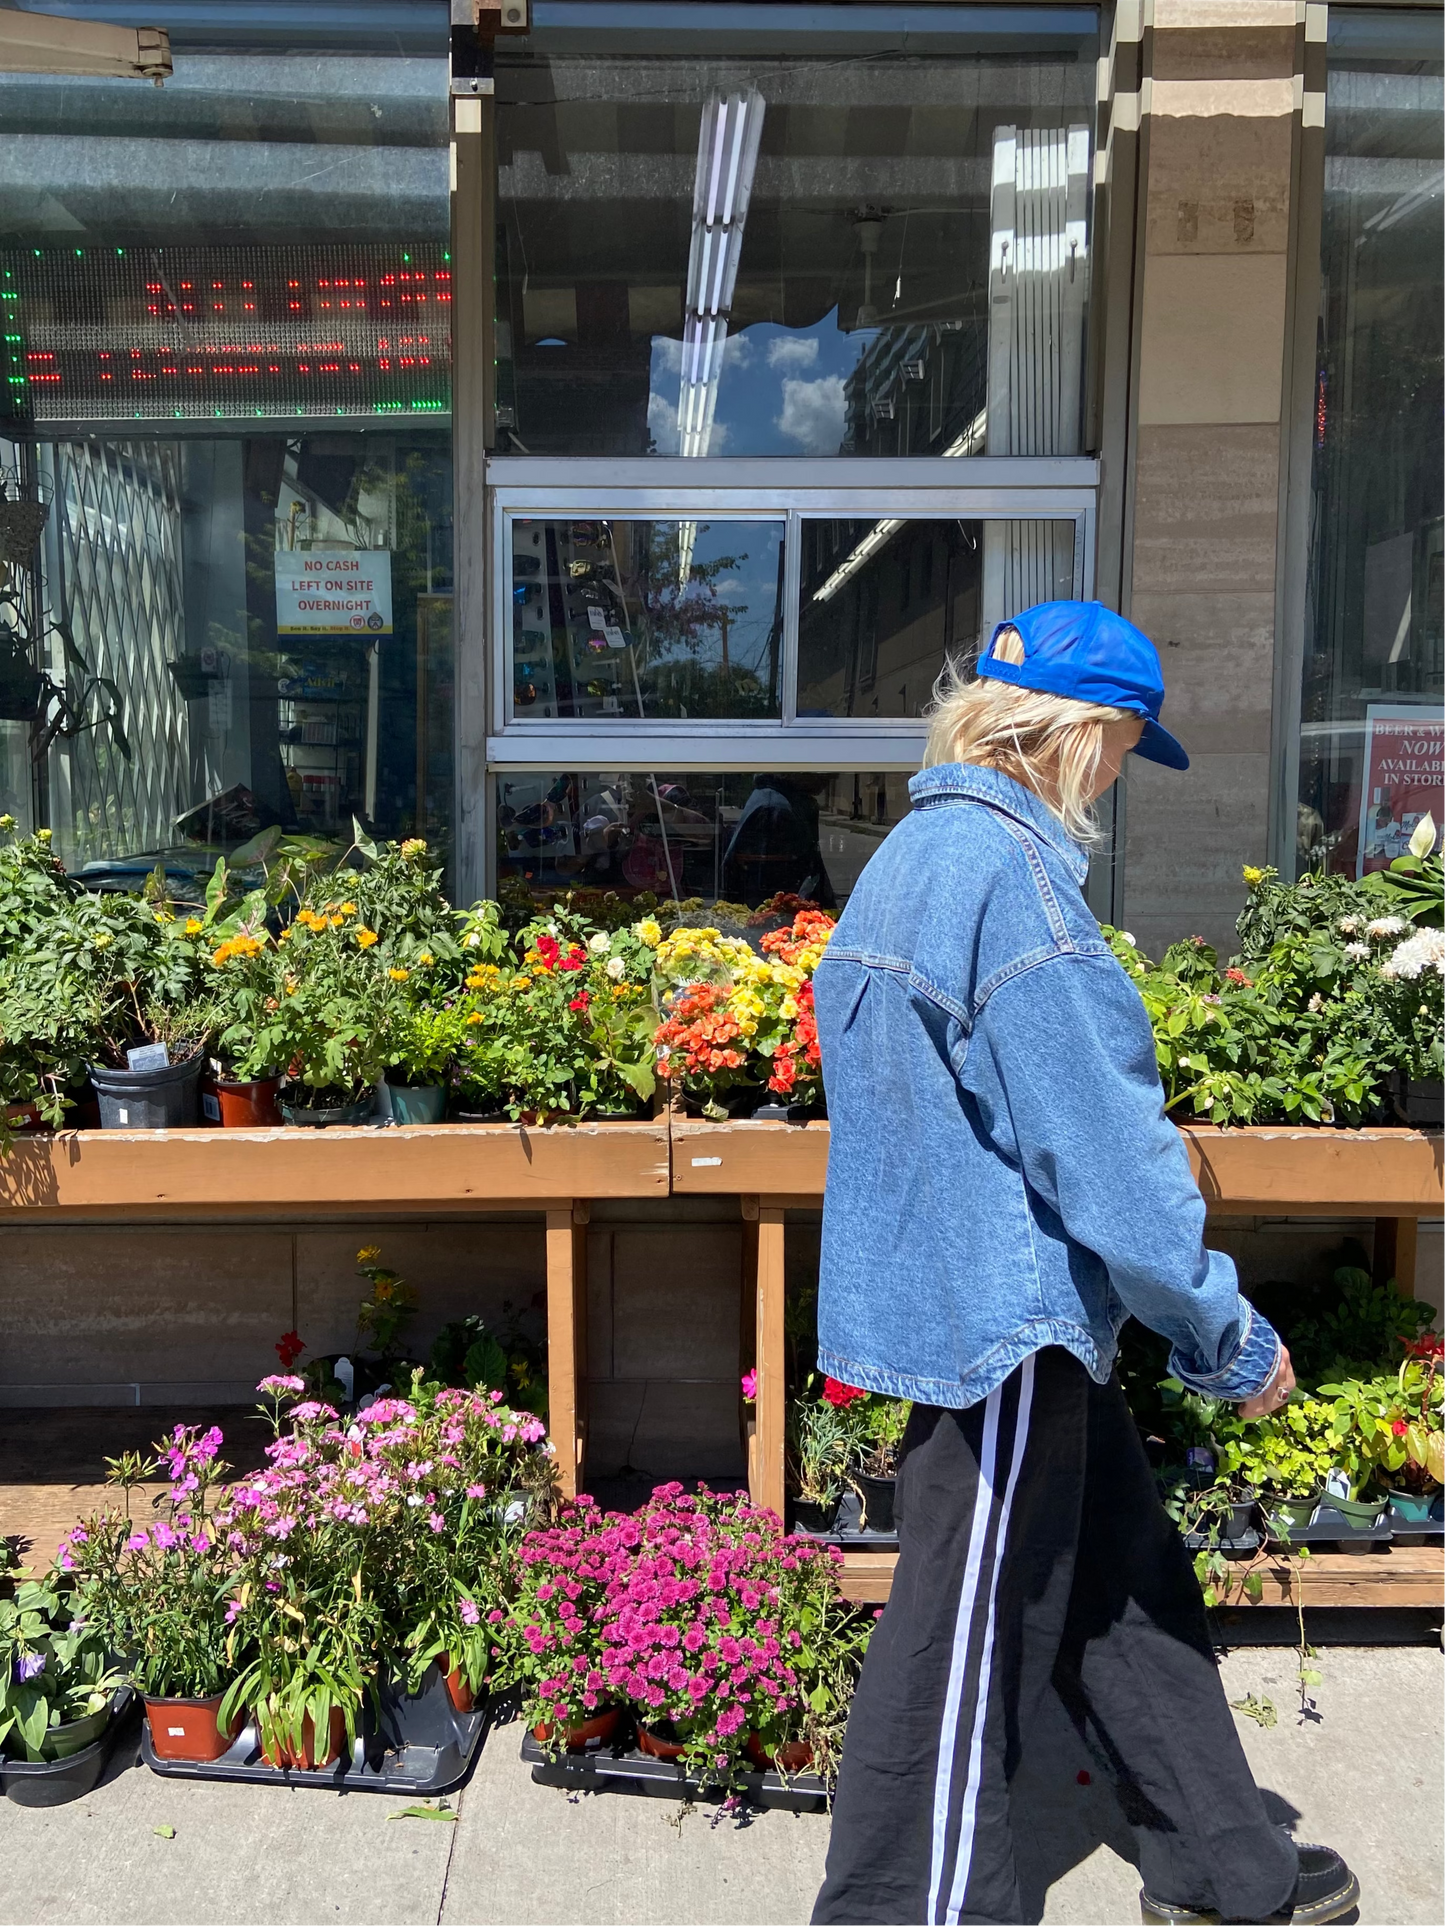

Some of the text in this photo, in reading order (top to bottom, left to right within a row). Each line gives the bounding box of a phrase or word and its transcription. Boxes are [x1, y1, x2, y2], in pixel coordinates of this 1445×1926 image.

[304, 560, 359, 571] NO CASH
[291, 580, 374, 591] LEFT ON SITE
[298, 600, 371, 611] OVERNIGHT
[1375, 724, 1445, 737] BEER & W
[1399, 740, 1445, 755] NOW
[1383, 773, 1445, 786] IN STOR
